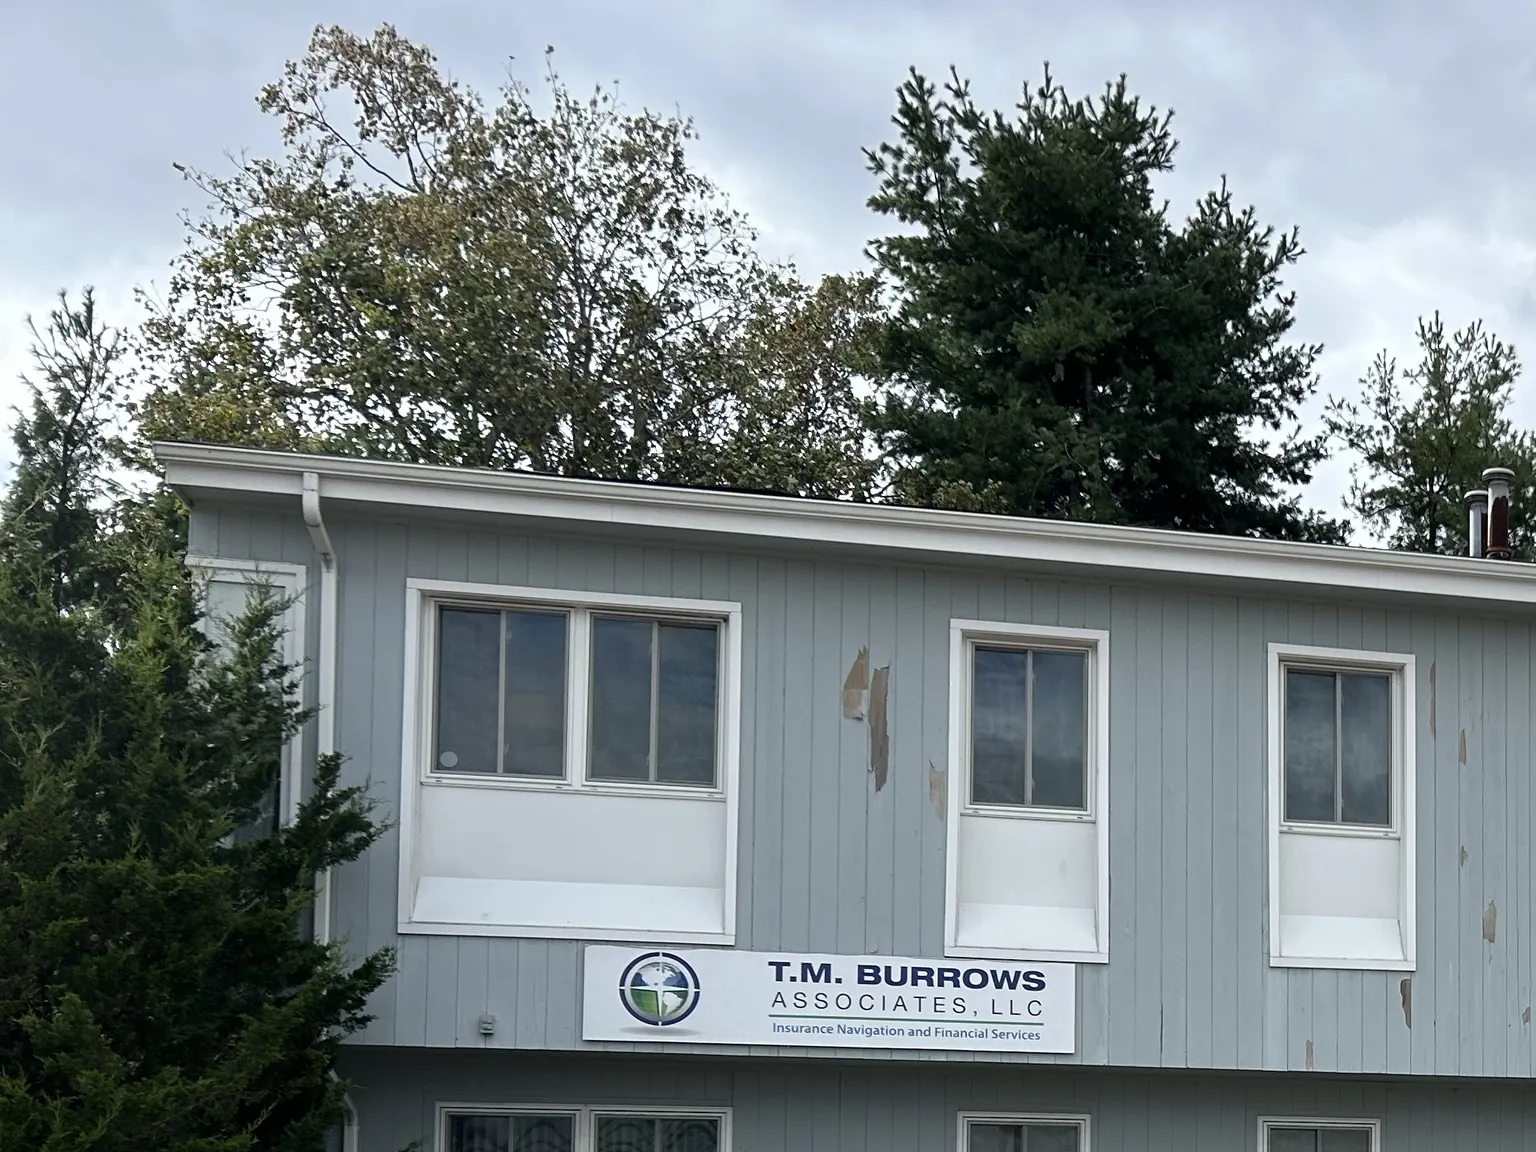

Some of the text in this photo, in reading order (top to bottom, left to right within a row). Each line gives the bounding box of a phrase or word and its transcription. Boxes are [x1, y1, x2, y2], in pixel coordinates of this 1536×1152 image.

[768, 961, 1046, 991] T.M. BURROWS
[771, 991, 1042, 1017] ASSOCIATES, LLC
[772, 1022, 1041, 1041] Insurance Navigation and Financial Services
